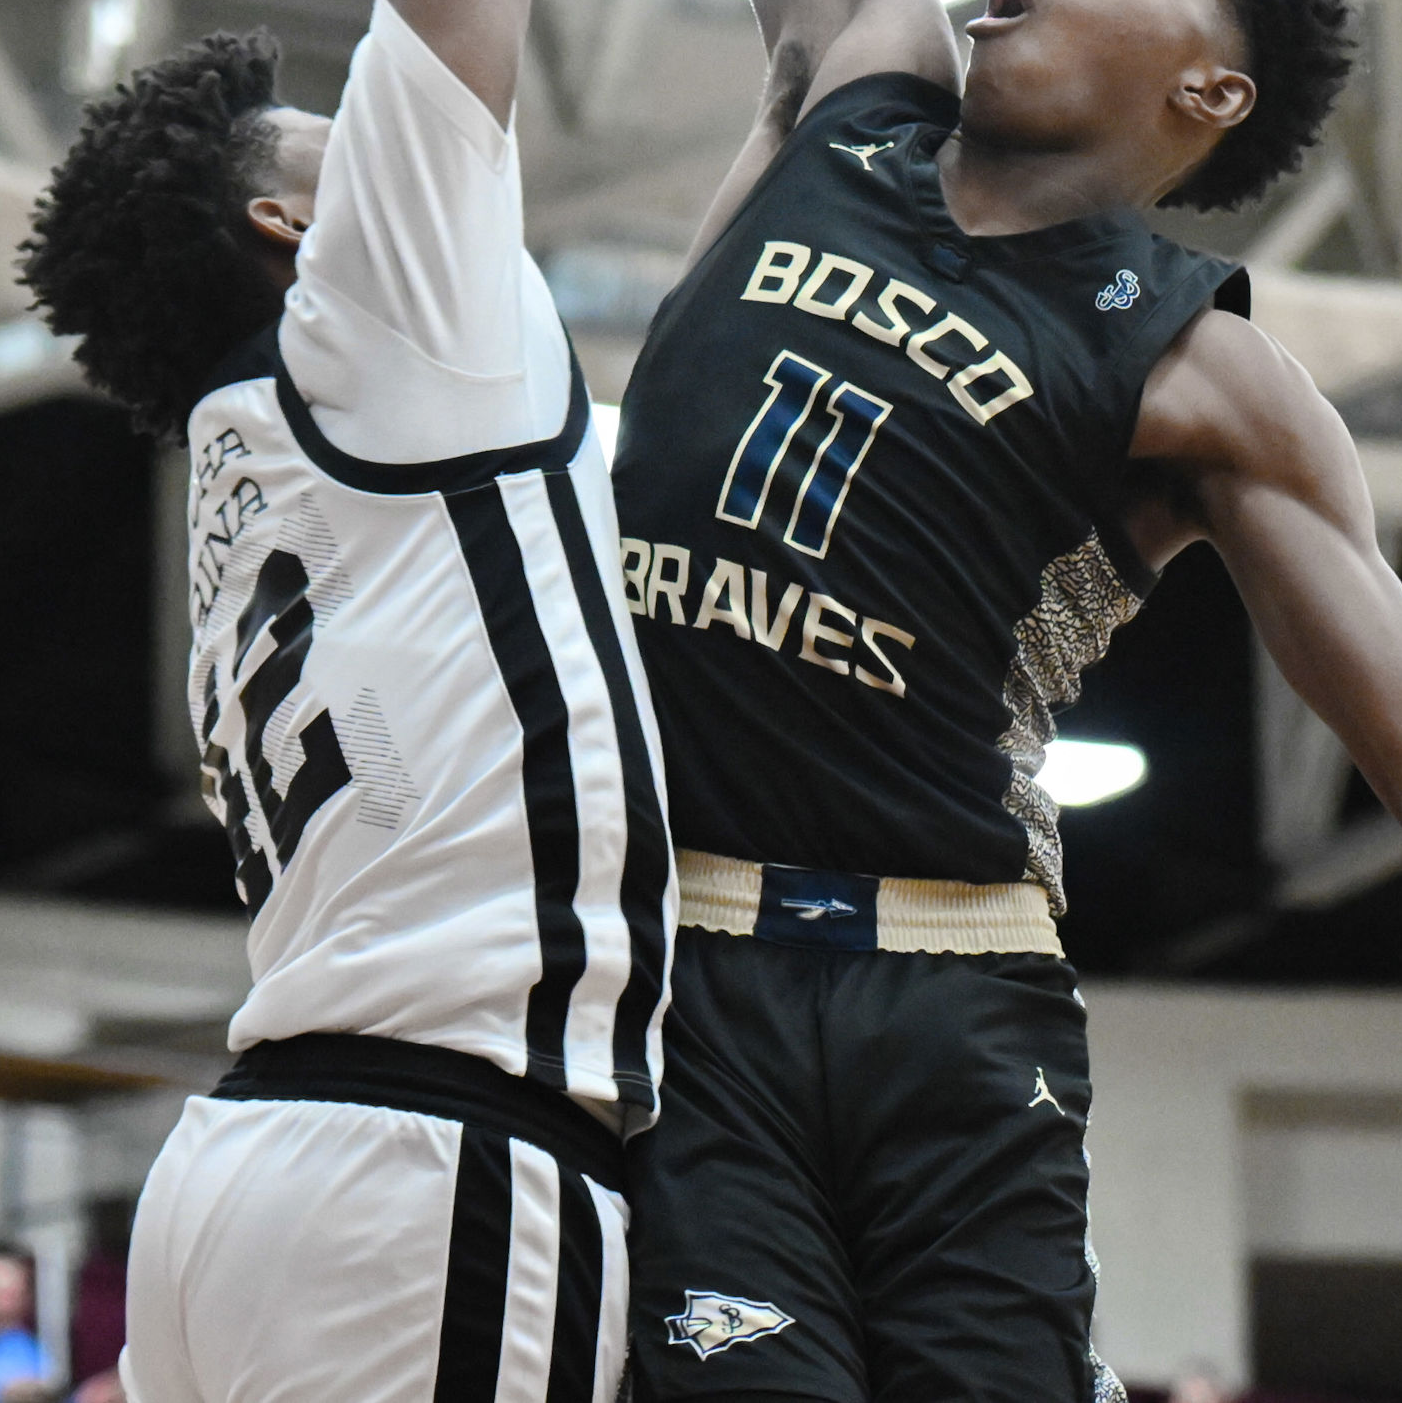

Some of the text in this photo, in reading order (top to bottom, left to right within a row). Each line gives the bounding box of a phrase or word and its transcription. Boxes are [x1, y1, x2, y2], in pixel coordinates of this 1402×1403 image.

[740, 240, 1035, 426] BOSCO
[714, 348, 894, 560] 11
[621, 537, 916, 700] BRAVES
